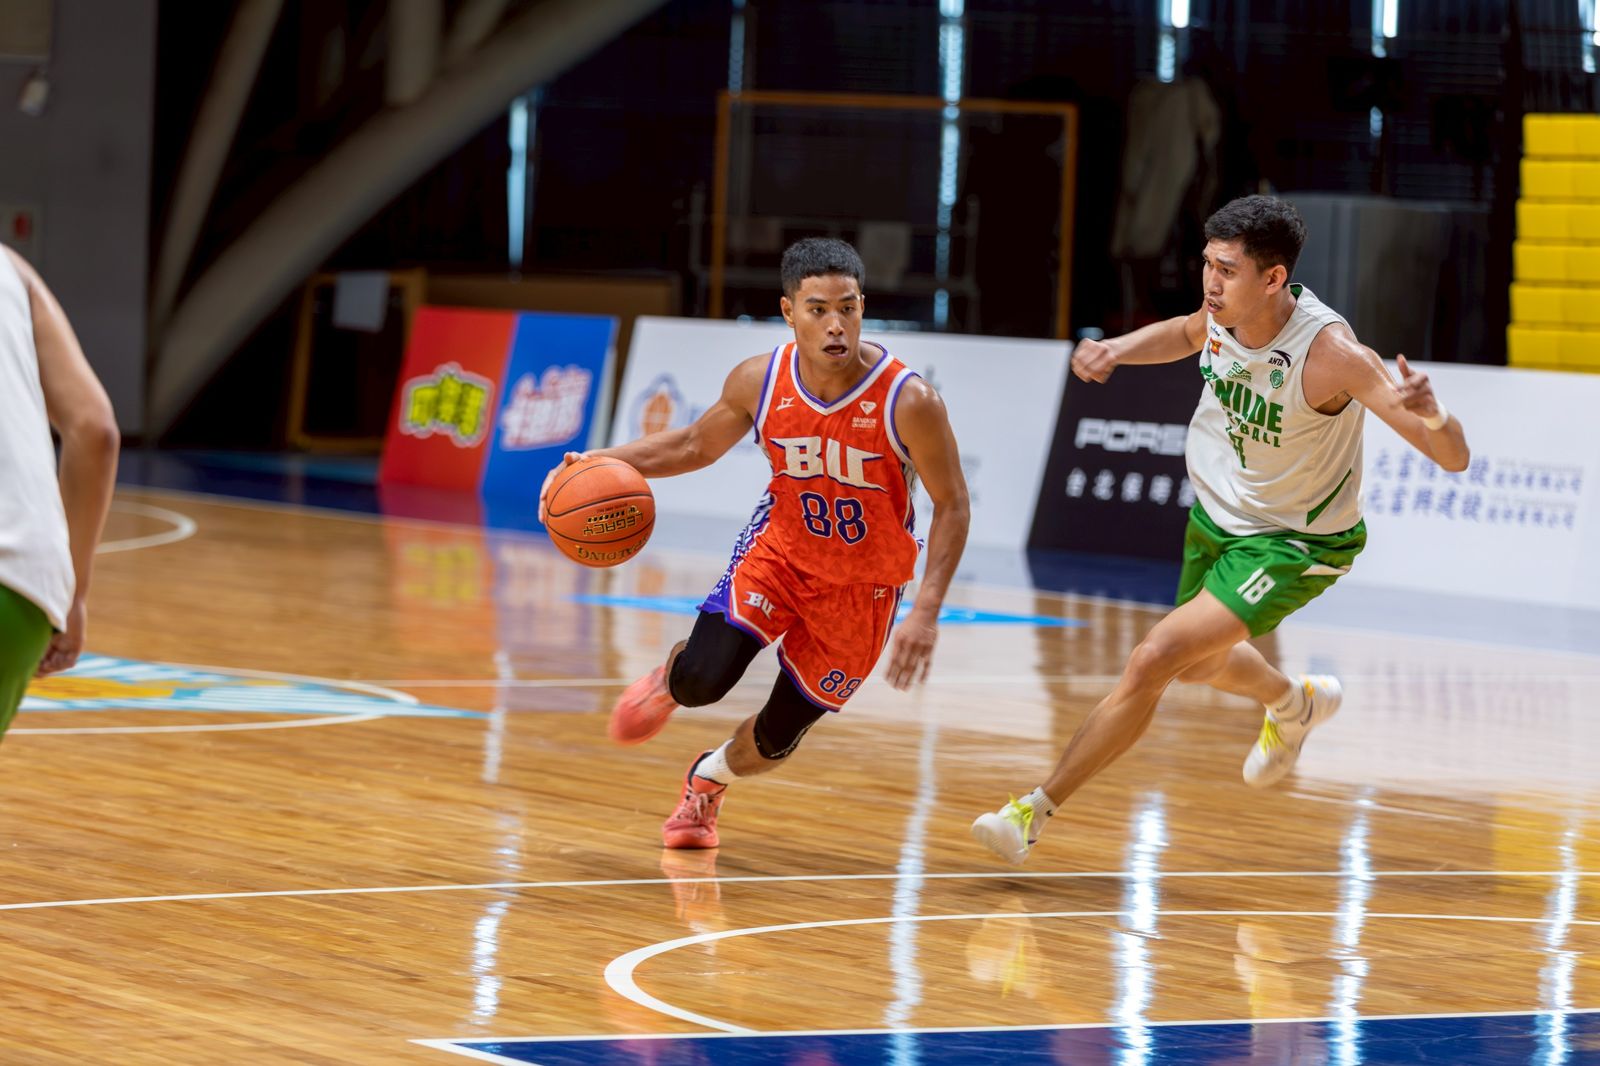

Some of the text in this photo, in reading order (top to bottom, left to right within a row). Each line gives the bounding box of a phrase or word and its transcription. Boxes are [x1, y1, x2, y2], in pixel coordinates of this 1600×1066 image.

[1267, 356, 1285, 368] ANTA
[1074, 417, 1188, 456] PORS
[769, 435, 889, 494] BU
[583, 512, 644, 537] LEGACY
[799, 491, 868, 545] 88
[1236, 567, 1276, 605] 18
[819, 669, 863, 699] 88
